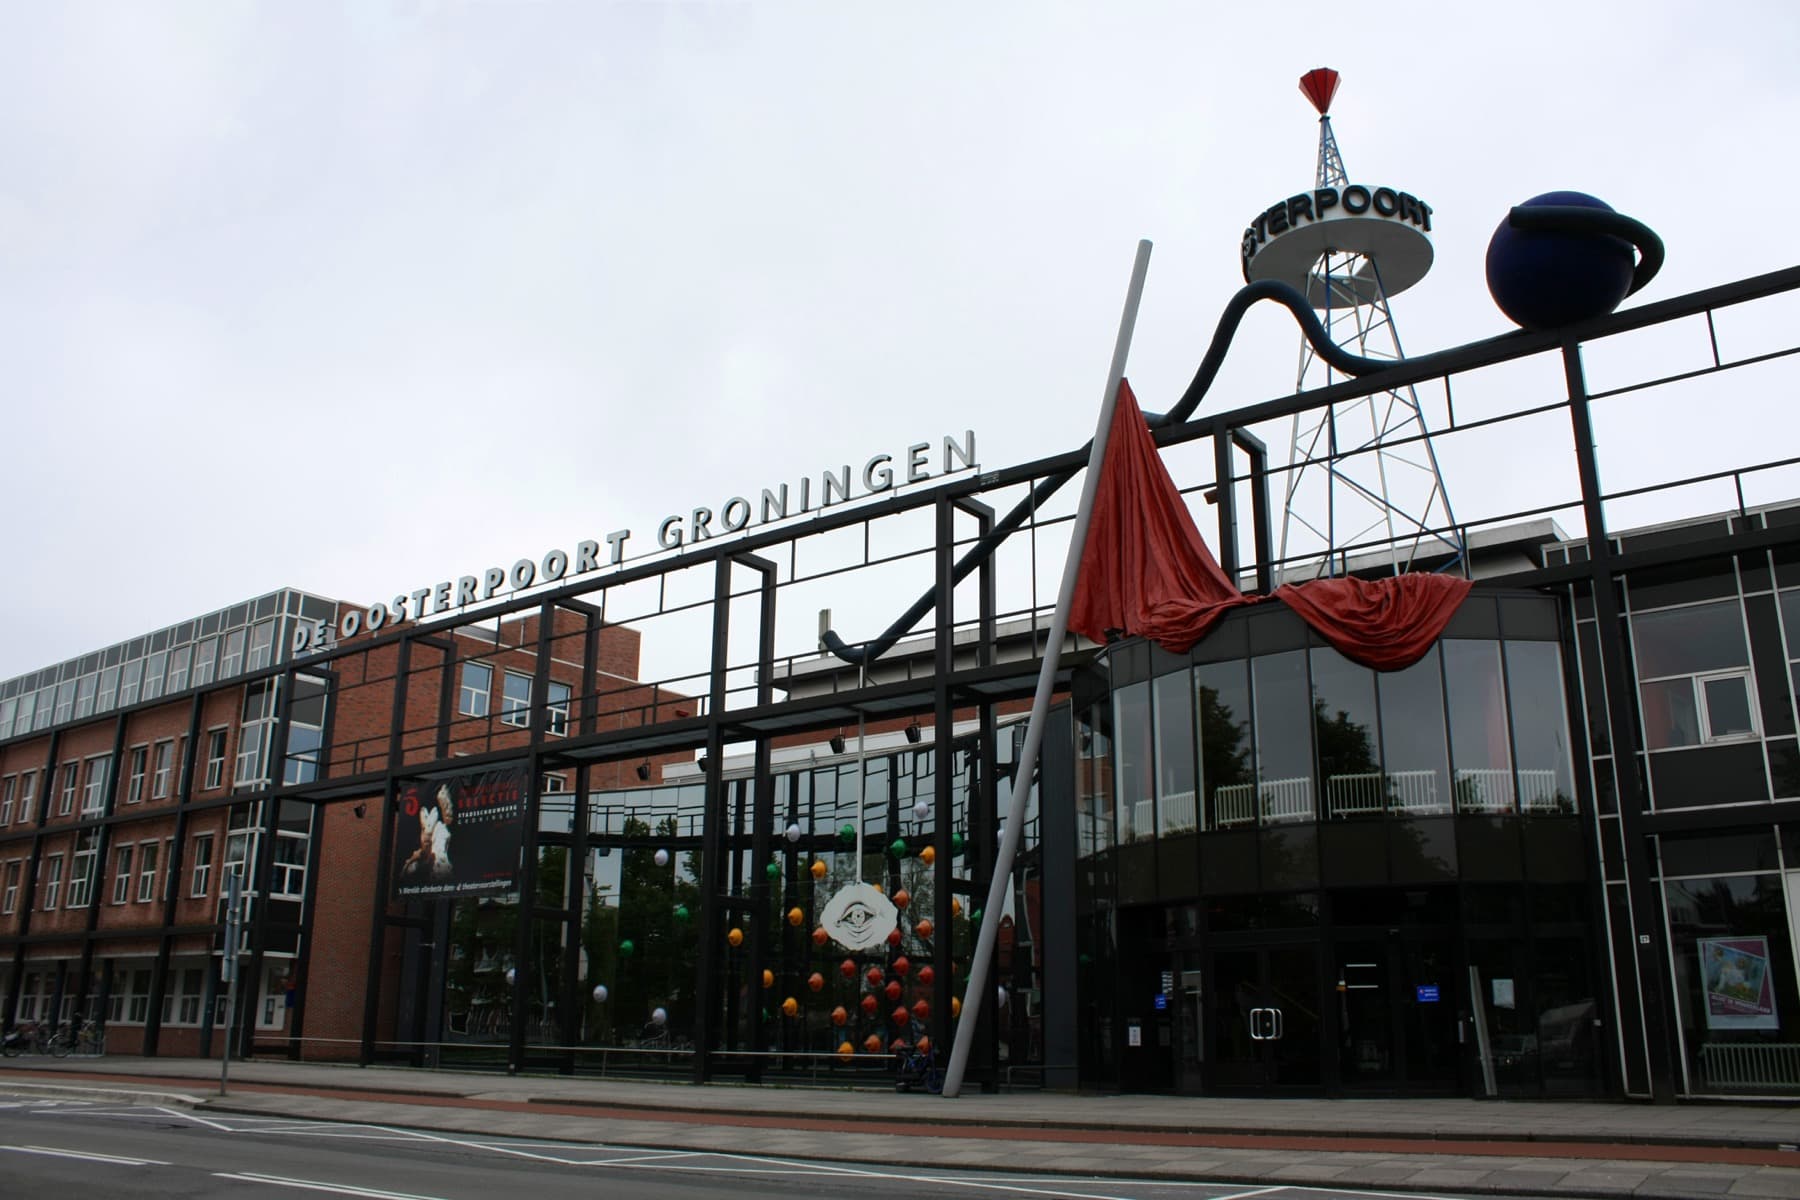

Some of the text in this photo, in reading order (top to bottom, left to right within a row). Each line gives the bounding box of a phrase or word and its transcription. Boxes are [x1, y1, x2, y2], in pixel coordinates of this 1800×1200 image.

[294, 430, 975, 653] DE OOSTERPOORT GRONINGEN
